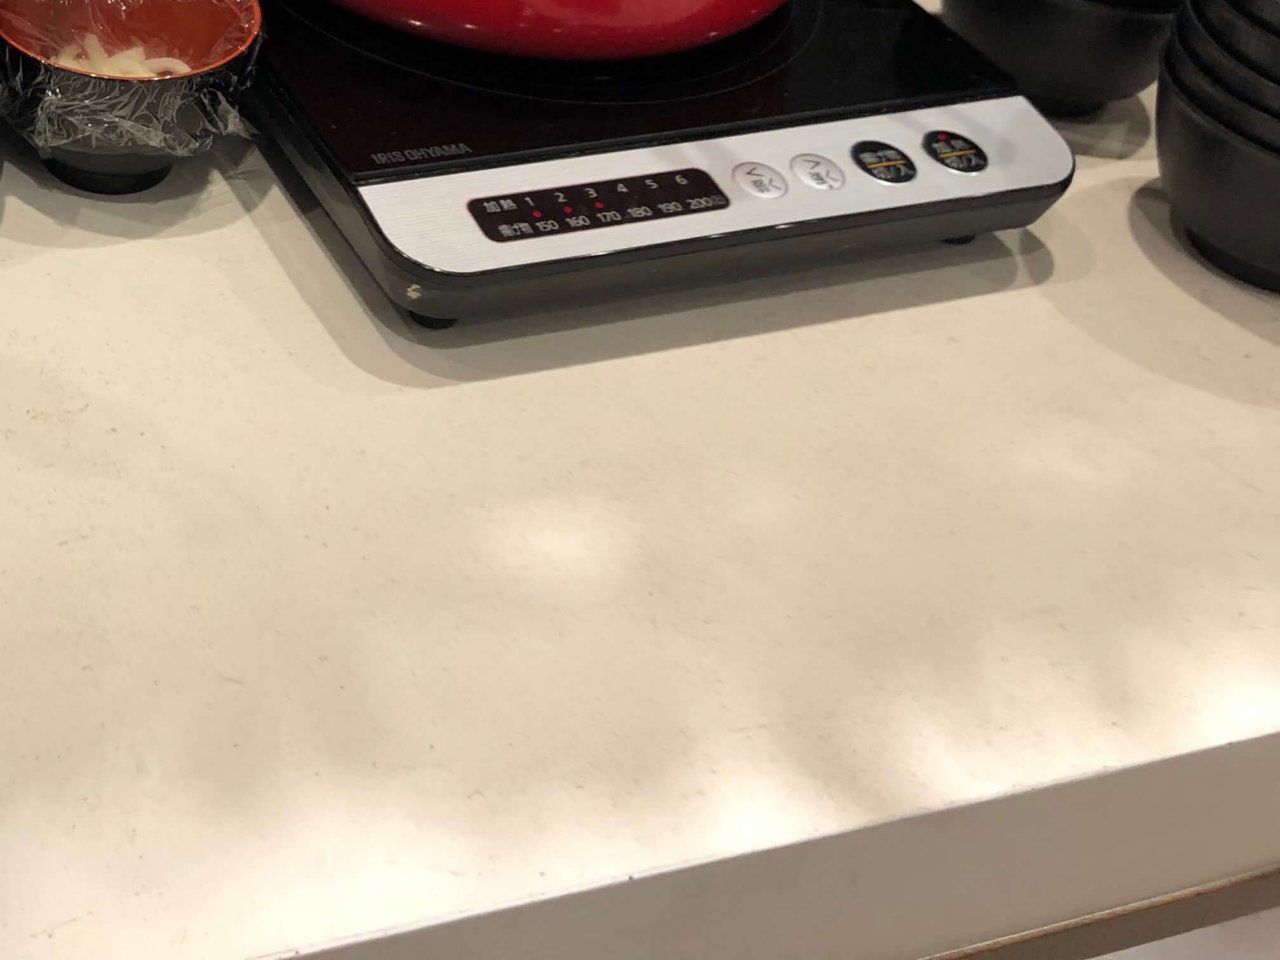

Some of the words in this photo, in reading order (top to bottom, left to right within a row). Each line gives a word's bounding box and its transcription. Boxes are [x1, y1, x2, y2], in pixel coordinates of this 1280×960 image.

[371, 151, 405, 164] IRIS
[404, 143, 472, 160] OHYAMA
[525, 197, 534, 206] 1
[554, 192, 568, 202] 2
[584, 188, 597, 198] 3
[617, 183, 628, 192] 4
[645, 179, 658, 189] 5
[675, 175, 688, 185] 6
[536, 220, 559, 232] 150
[565, 215, 590, 227] 160
[596, 211, 621, 222] 170
[627, 206, 653, 218] 180
[657, 202, 683, 213] 190
